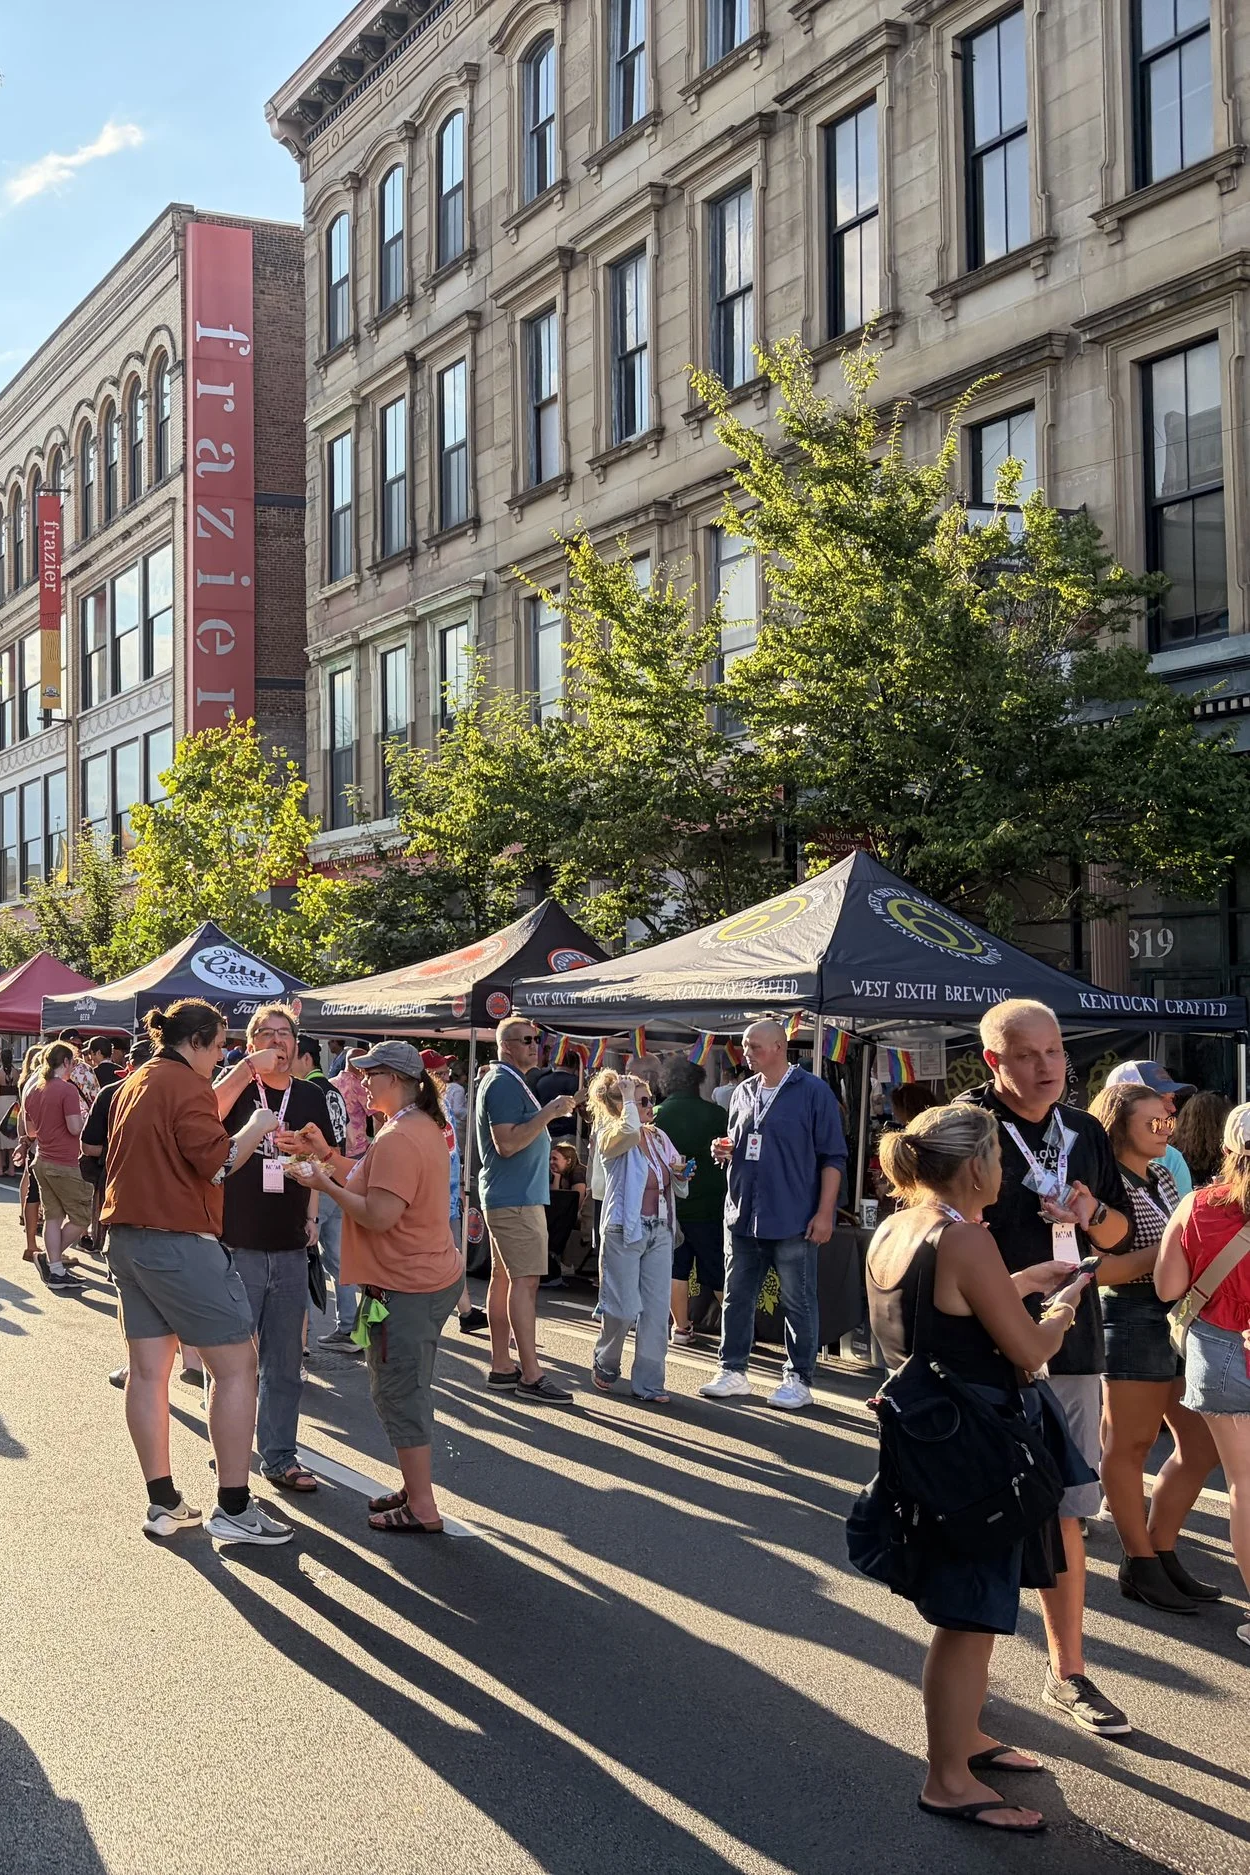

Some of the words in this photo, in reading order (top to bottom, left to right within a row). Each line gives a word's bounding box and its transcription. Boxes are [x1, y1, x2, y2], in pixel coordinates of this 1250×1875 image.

[196, 321, 250, 718] frazier
[44, 520, 60, 592] frazier
[1128, 928, 1174, 958] 819
[214, 949, 241, 959] OUR
[558, 952, 592, 971] COUNTR
[198, 955, 271, 983] City
[229, 980, 269, 989] BEER
[851, 980, 890, 997] WEST
[895, 982, 936, 1000] SIXTH
[945, 985, 1011, 1003] BREWING
[321, 1000, 362, 1015] COUNTRY
[526, 993, 549, 1006] WEST
[551, 992, 577, 1005] SIXTH
[1078, 993, 1159, 1013] KENTUCKY
